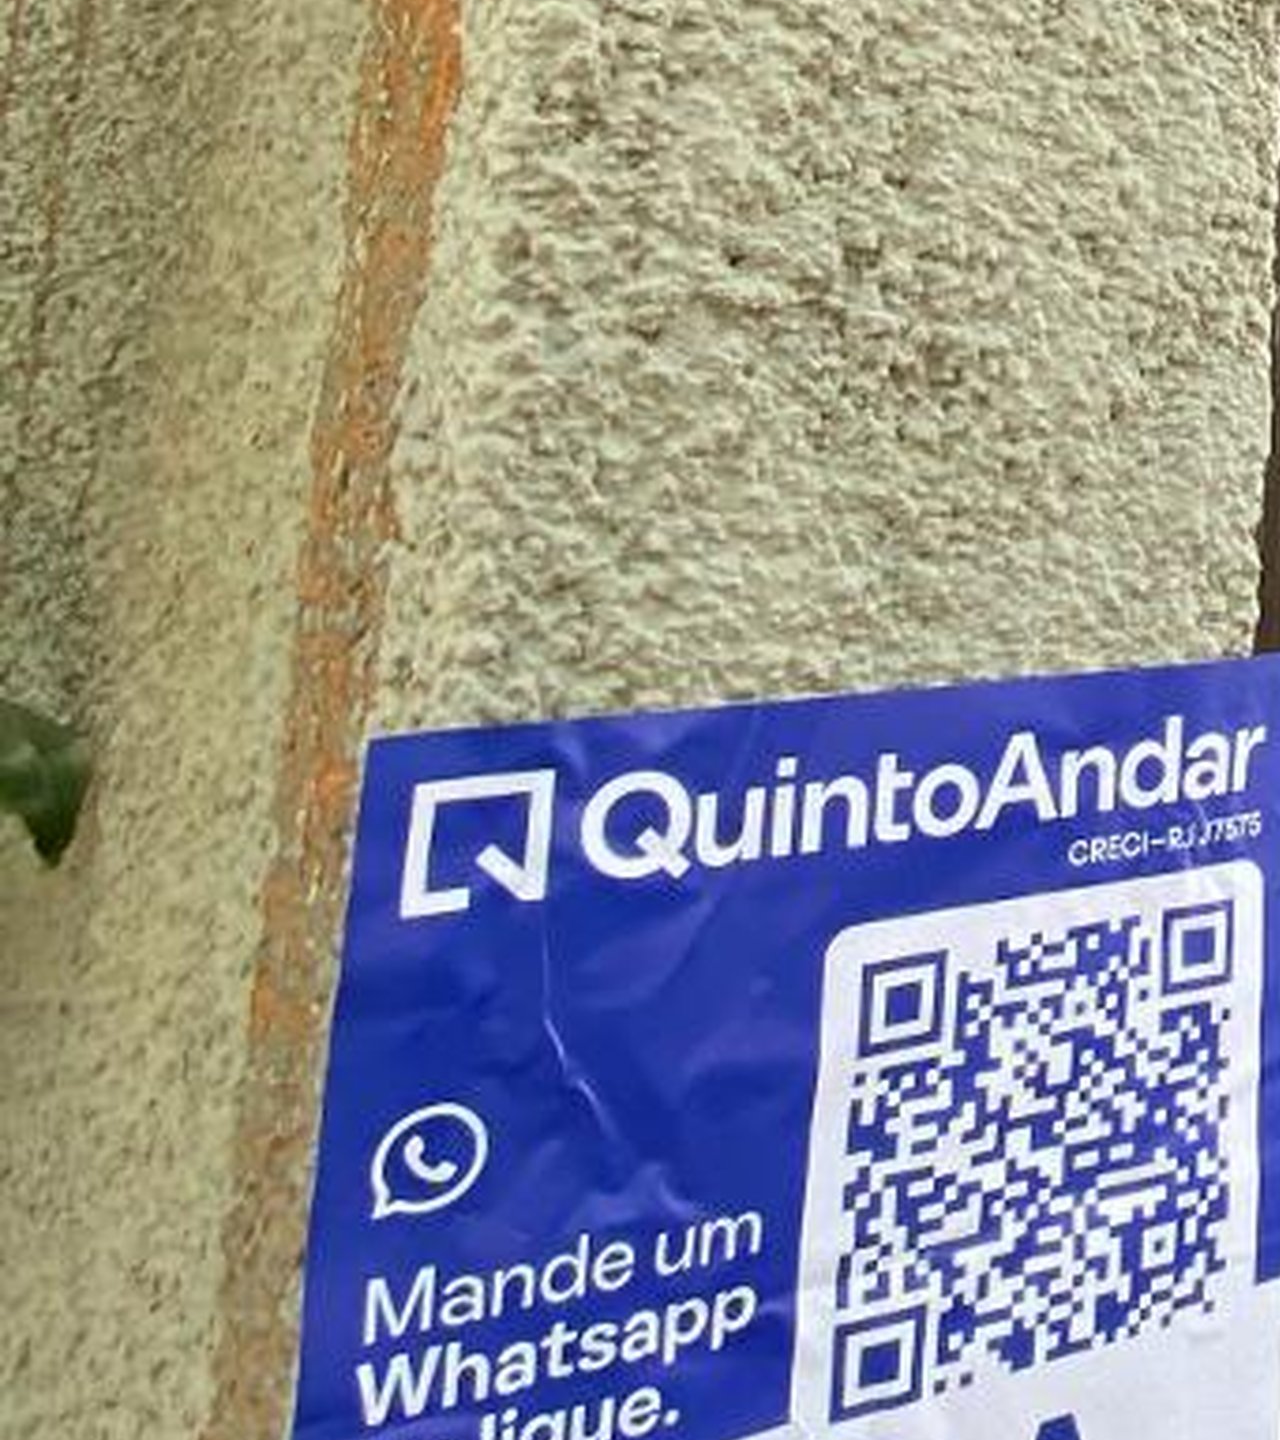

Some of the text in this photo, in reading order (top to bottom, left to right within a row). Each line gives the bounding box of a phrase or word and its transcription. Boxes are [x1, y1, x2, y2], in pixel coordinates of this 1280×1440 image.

[579, 714, 1268, 880] QuintoAndar
[363, 1210, 762, 1346] Mande um
[356, 1284, 757, 1428] Whatsapp
